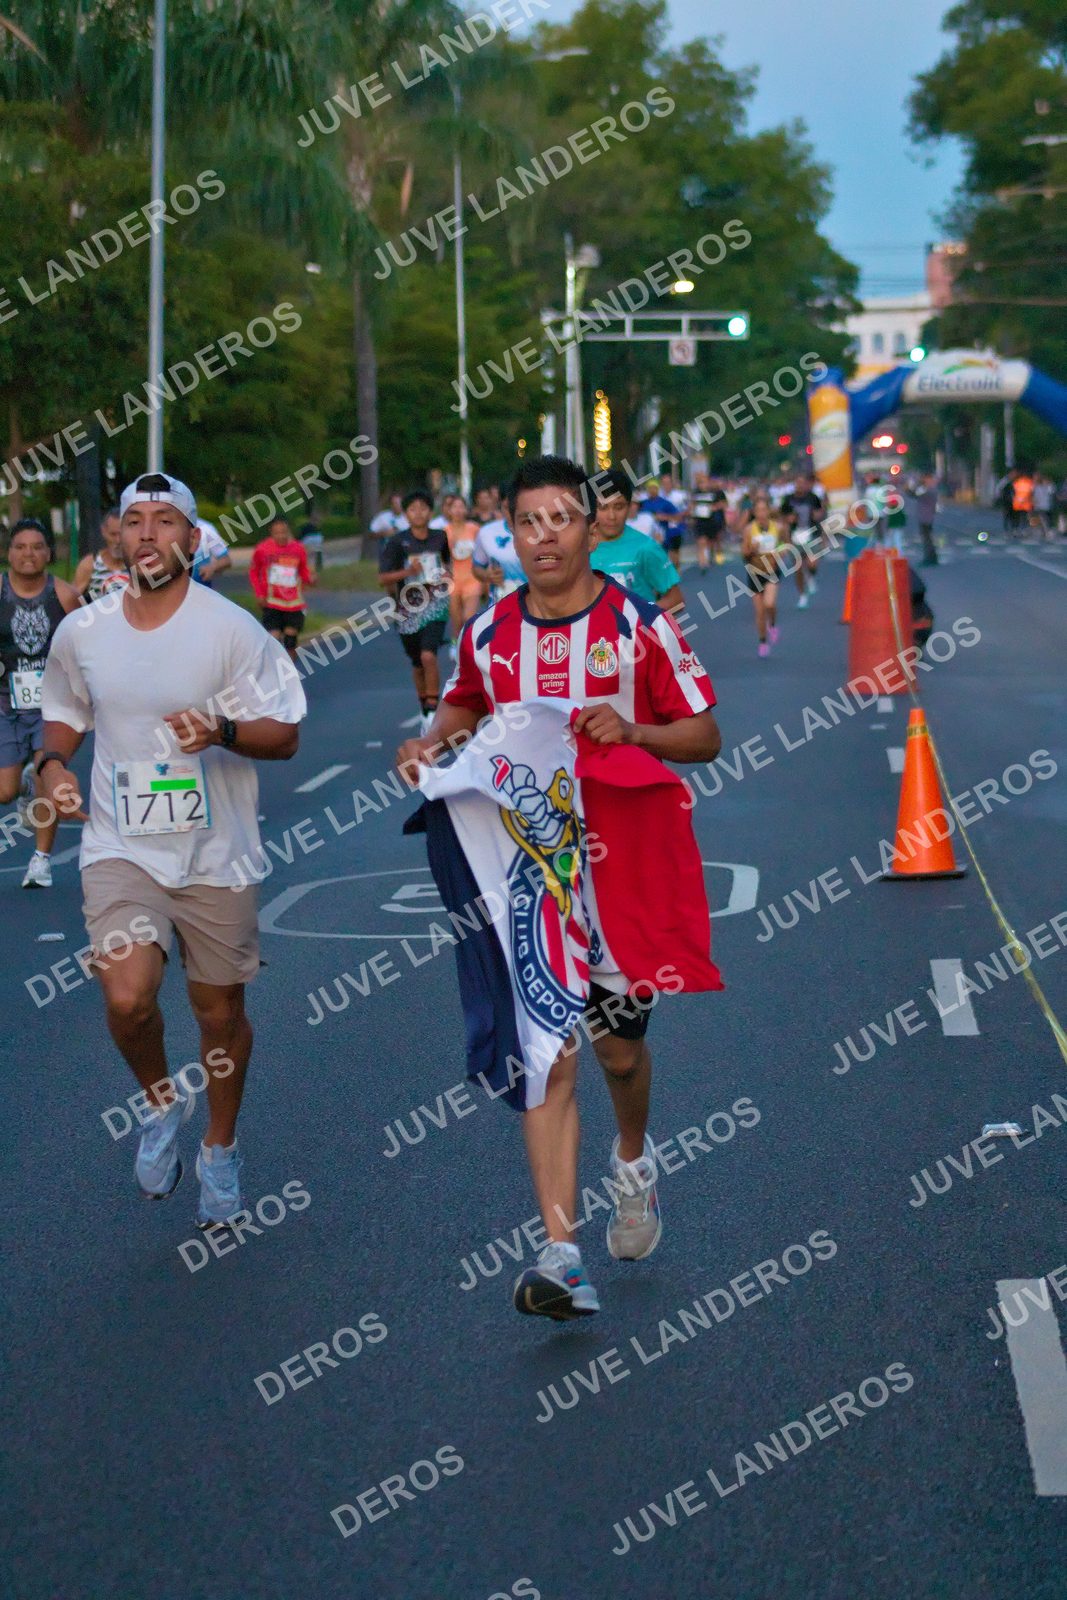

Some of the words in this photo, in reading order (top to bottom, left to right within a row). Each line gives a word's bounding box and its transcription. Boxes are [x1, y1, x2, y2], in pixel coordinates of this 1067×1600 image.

[542, 637, 566, 660] MG
[538, 672, 567, 680] amazon
[542, 680, 565, 689] prime
[121, 790, 204, 826] 1712
